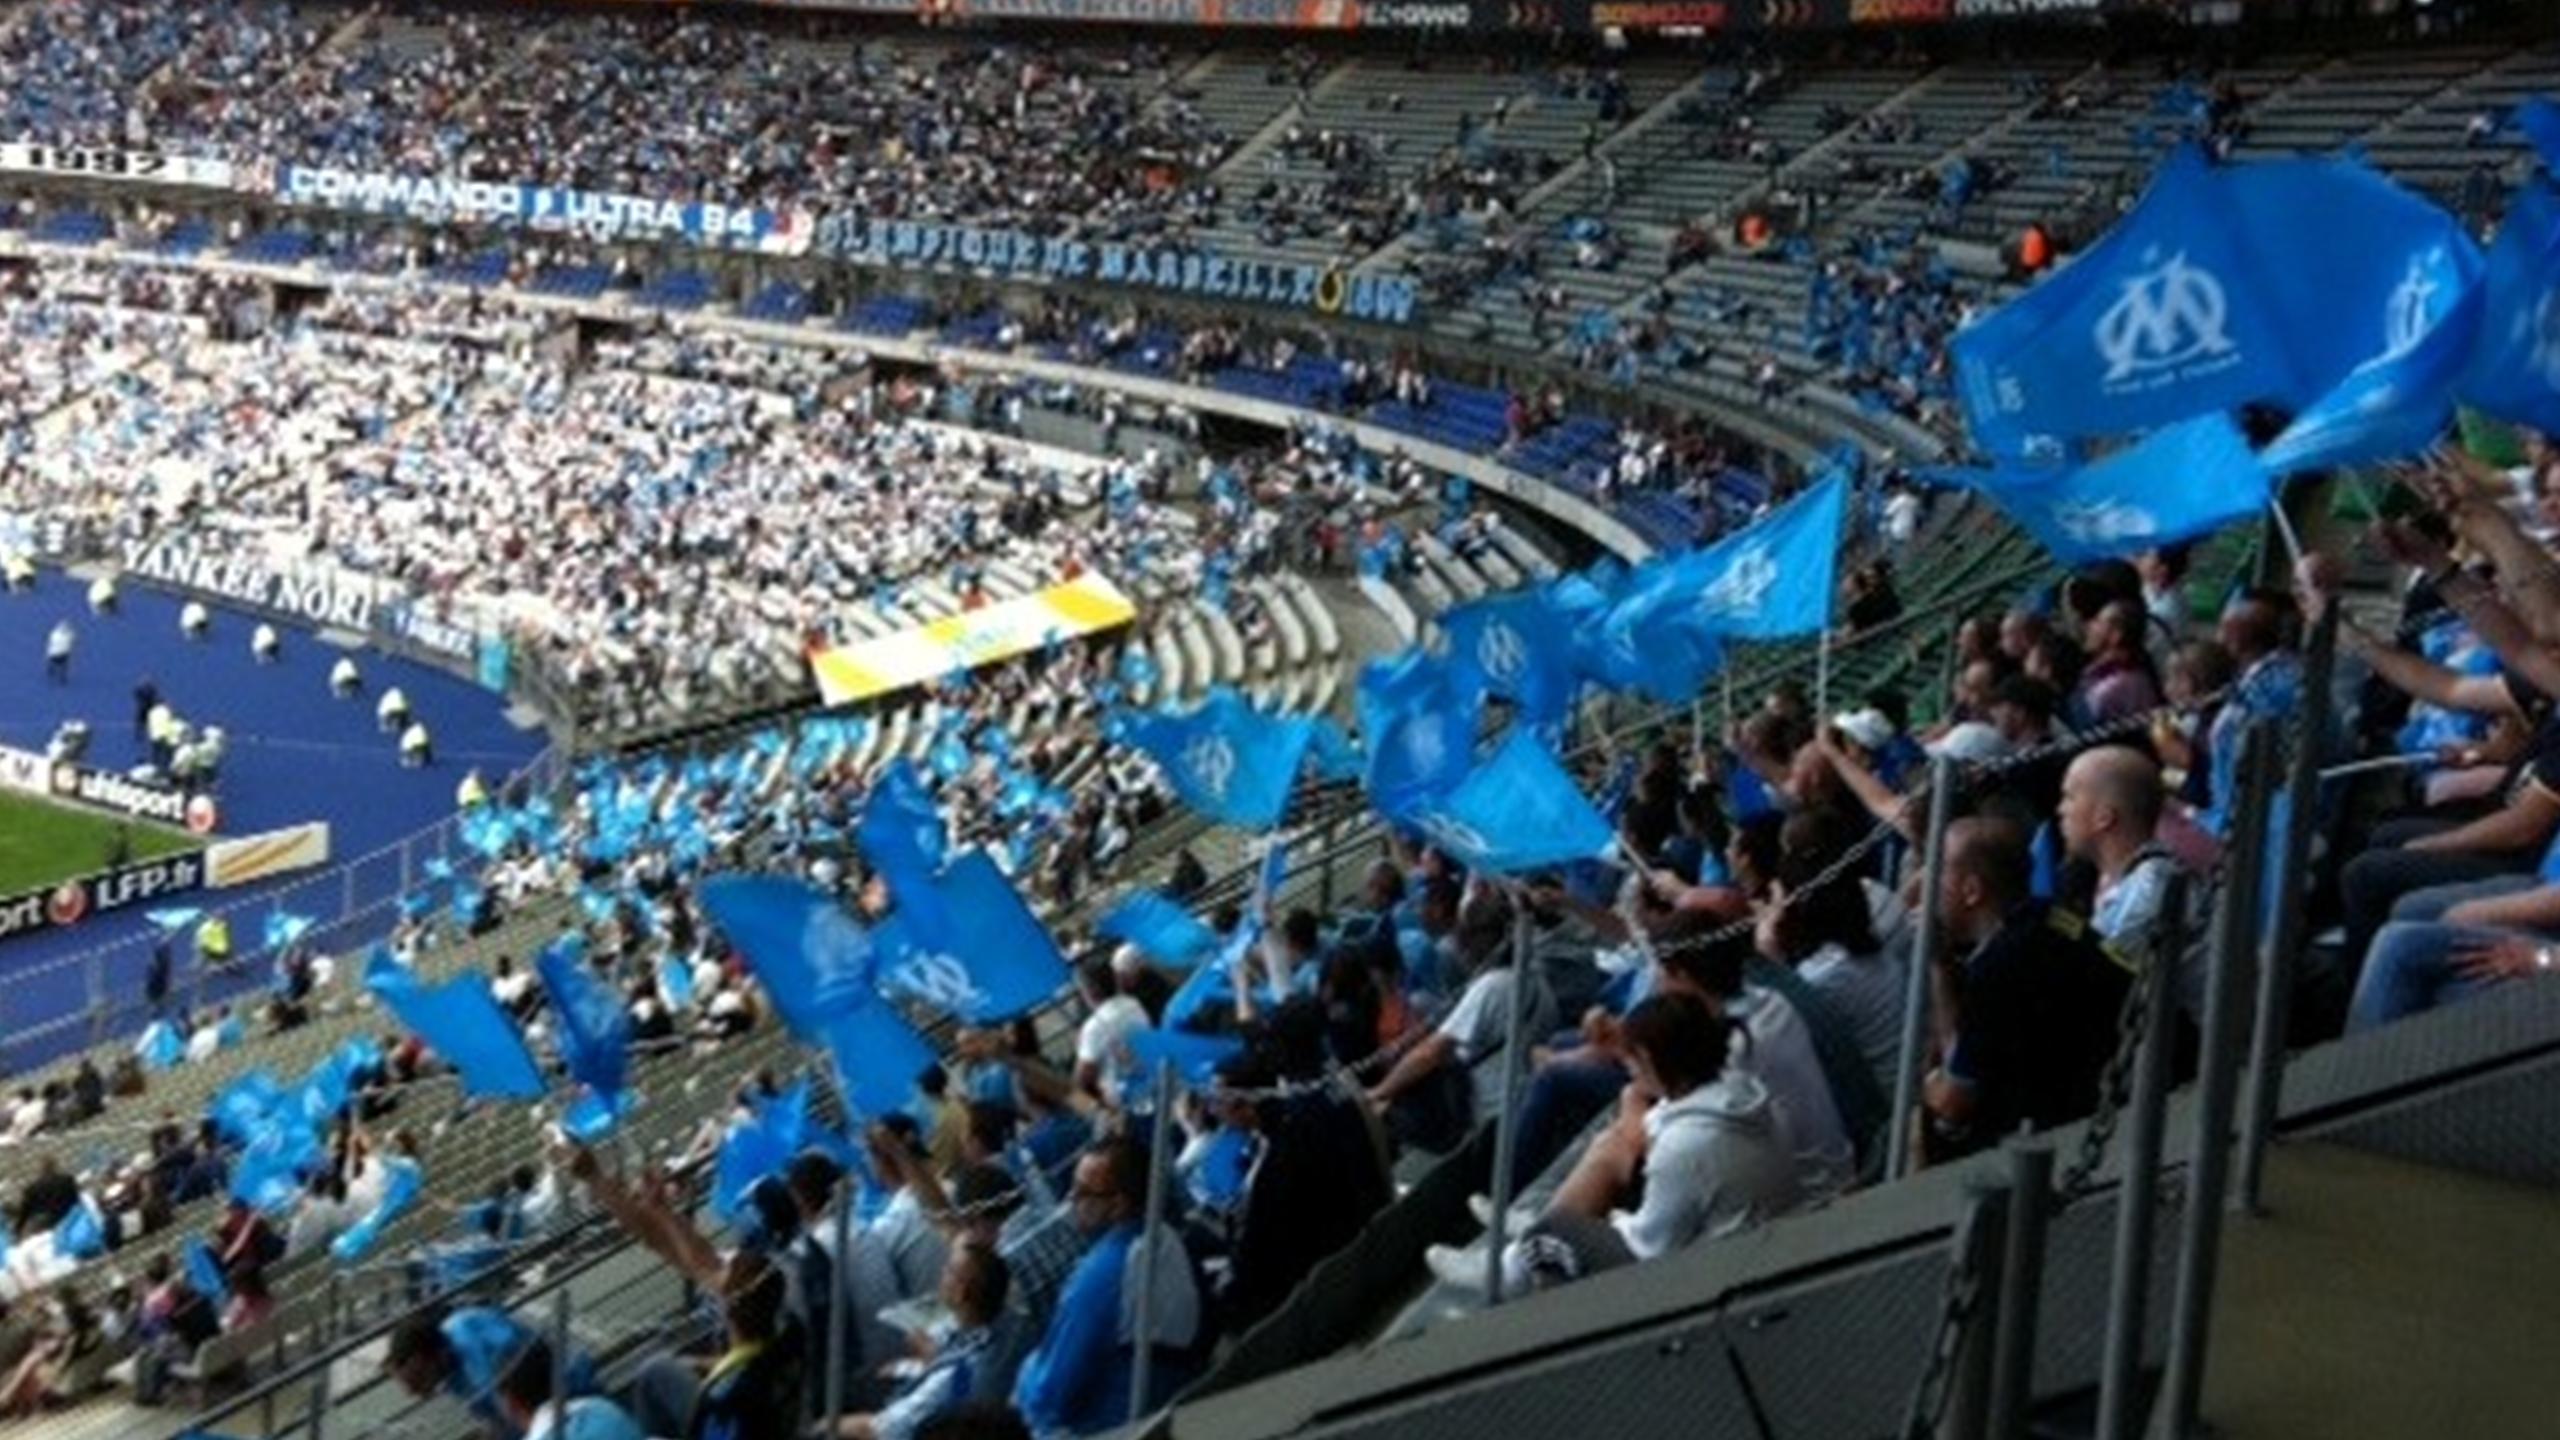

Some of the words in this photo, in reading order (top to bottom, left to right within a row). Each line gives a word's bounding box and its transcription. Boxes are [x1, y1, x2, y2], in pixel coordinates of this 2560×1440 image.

[290, 167, 521, 212] COMMANDO
[566, 191, 685, 231] ULTRA
[702, 202, 755, 237] 84
[1100, 243, 1315, 304] MARSEILLE
[121, 537, 270, 603] YANKEE
